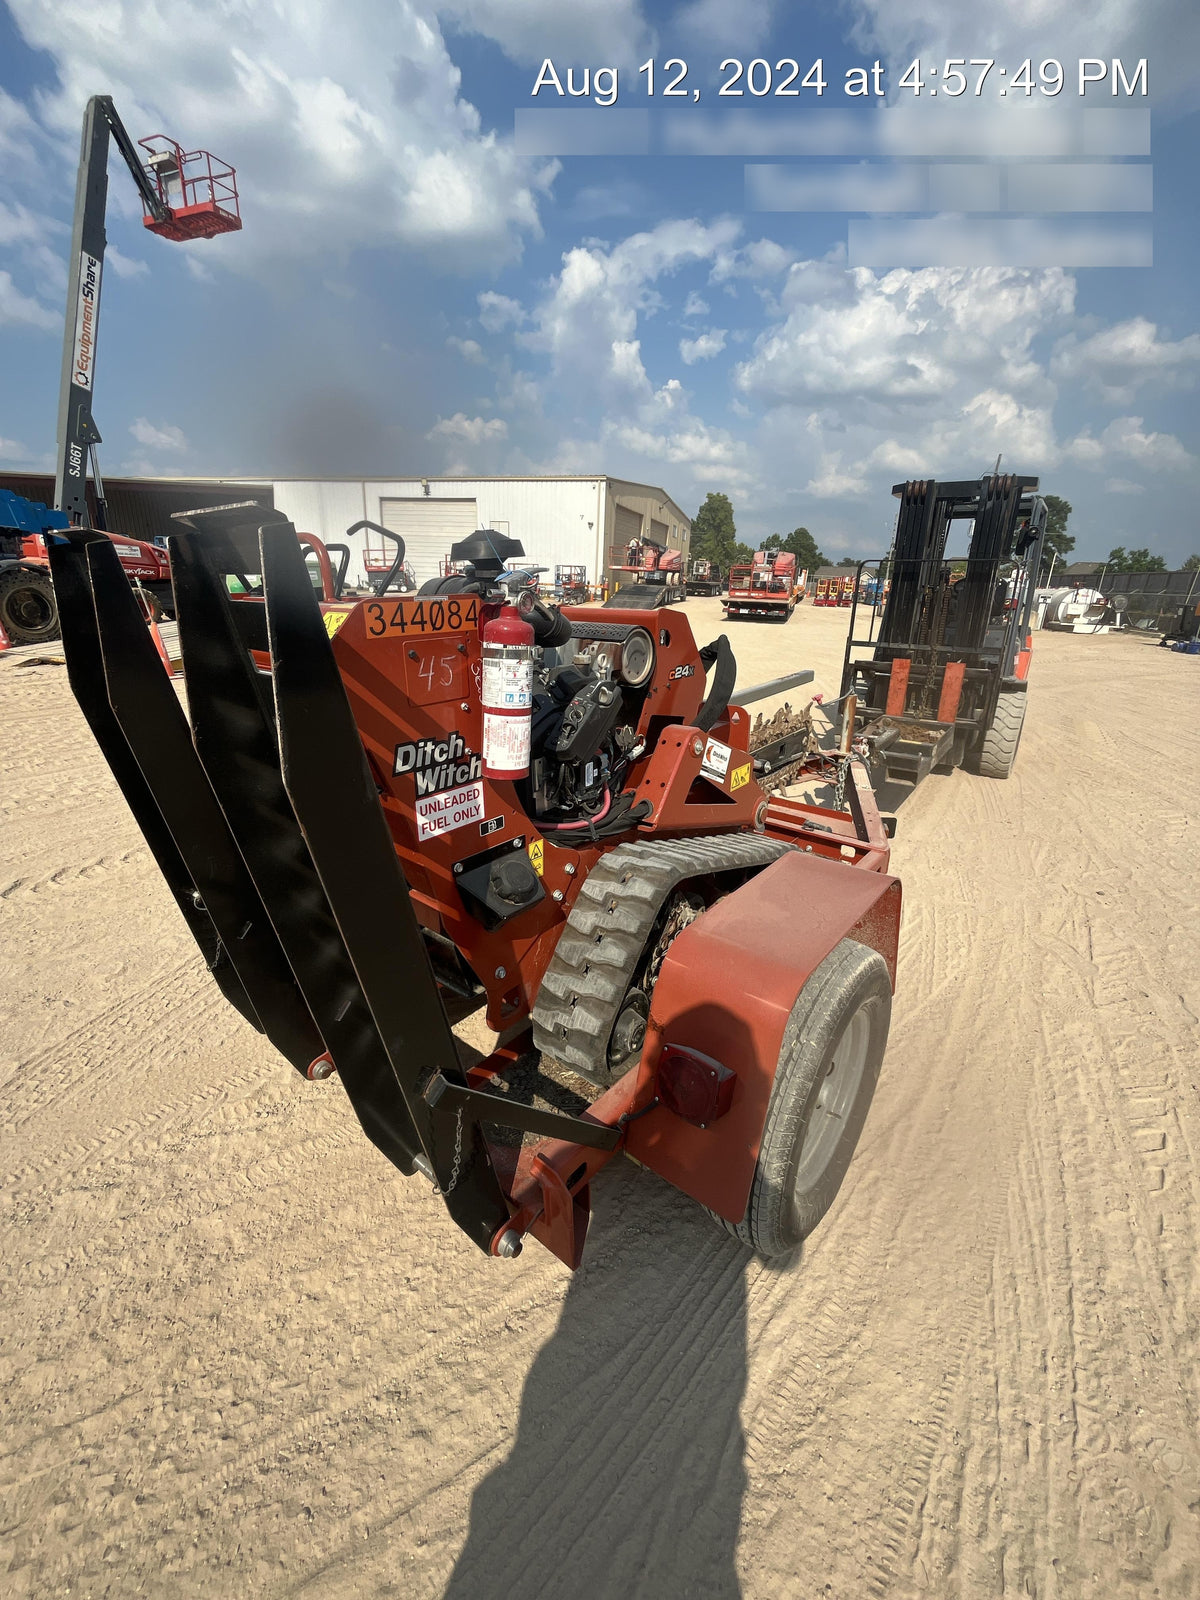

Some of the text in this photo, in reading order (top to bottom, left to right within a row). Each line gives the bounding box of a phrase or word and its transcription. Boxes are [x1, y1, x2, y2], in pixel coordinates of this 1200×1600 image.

[77, 256, 97, 371] EquipmentShare
[69, 442, 82, 477] SJ66T
[367, 600, 479, 635] 344084
[418, 655, 457, 691] 45
[395, 733, 464, 774] Ditch
[415, 755, 482, 796] Witch
[420, 788, 480, 817] UNLEADED
[421, 804, 480, 835] FUEL ONLY
